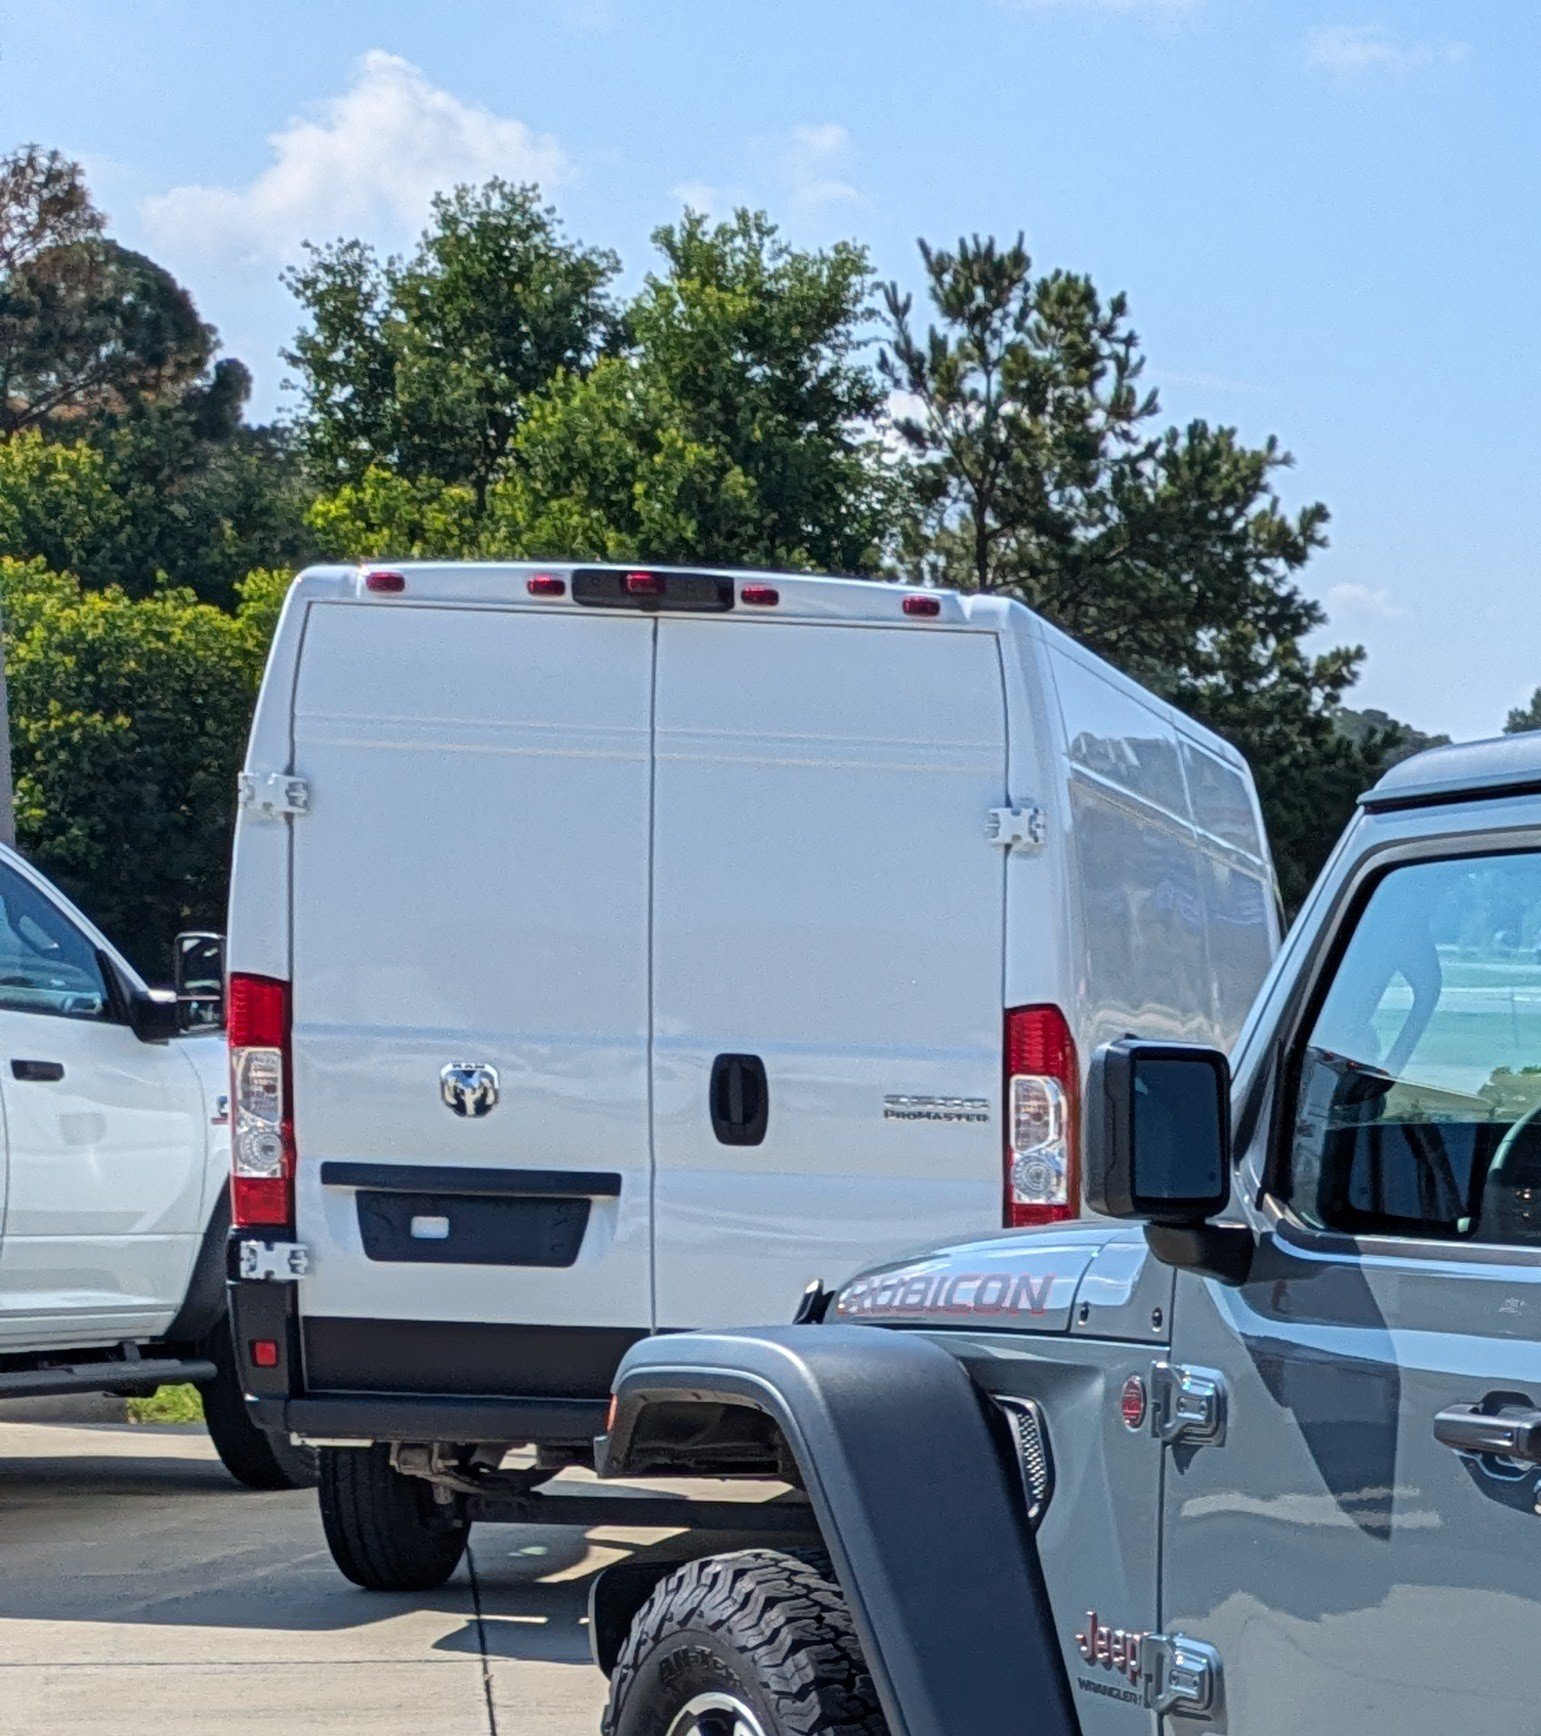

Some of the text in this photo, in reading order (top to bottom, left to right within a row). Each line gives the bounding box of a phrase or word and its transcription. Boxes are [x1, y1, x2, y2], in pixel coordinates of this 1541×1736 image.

[838, 1272, 1056, 1316] RUBICON
[1074, 1609, 1141, 1688] Jeep
[1078, 1676, 1138, 1705] WRANGLER
